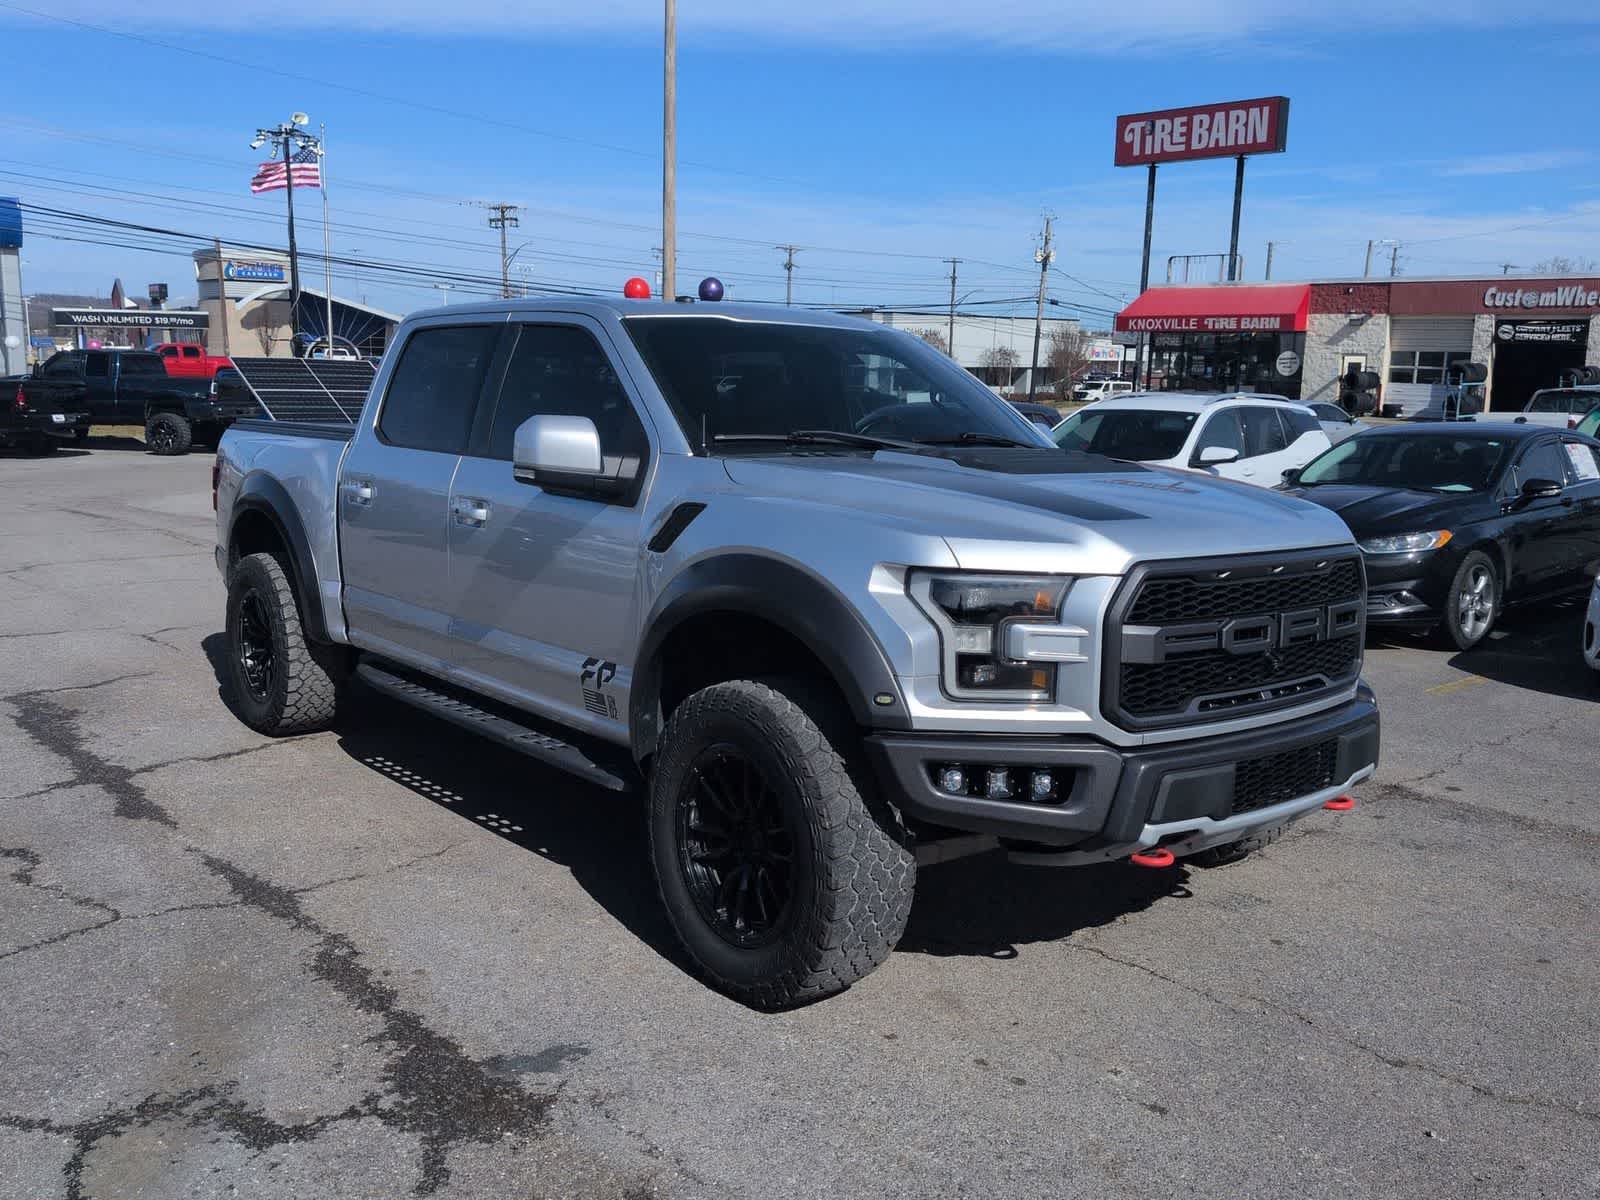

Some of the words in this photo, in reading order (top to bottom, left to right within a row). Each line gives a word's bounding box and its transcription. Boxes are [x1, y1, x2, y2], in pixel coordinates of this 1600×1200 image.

[1191, 106, 1269, 150] BARN
[1485, 285, 1600, 308] CustomWhe
[72, 315, 101, 323] WASH
[102, 315, 152, 324] UNLIMITED
[1128, 318, 1198, 330] KNOXVILLE
[1240, 316, 1281, 329] BARN
[1121, 600, 1360, 664] FORD
[580, 657, 617, 689] FP
